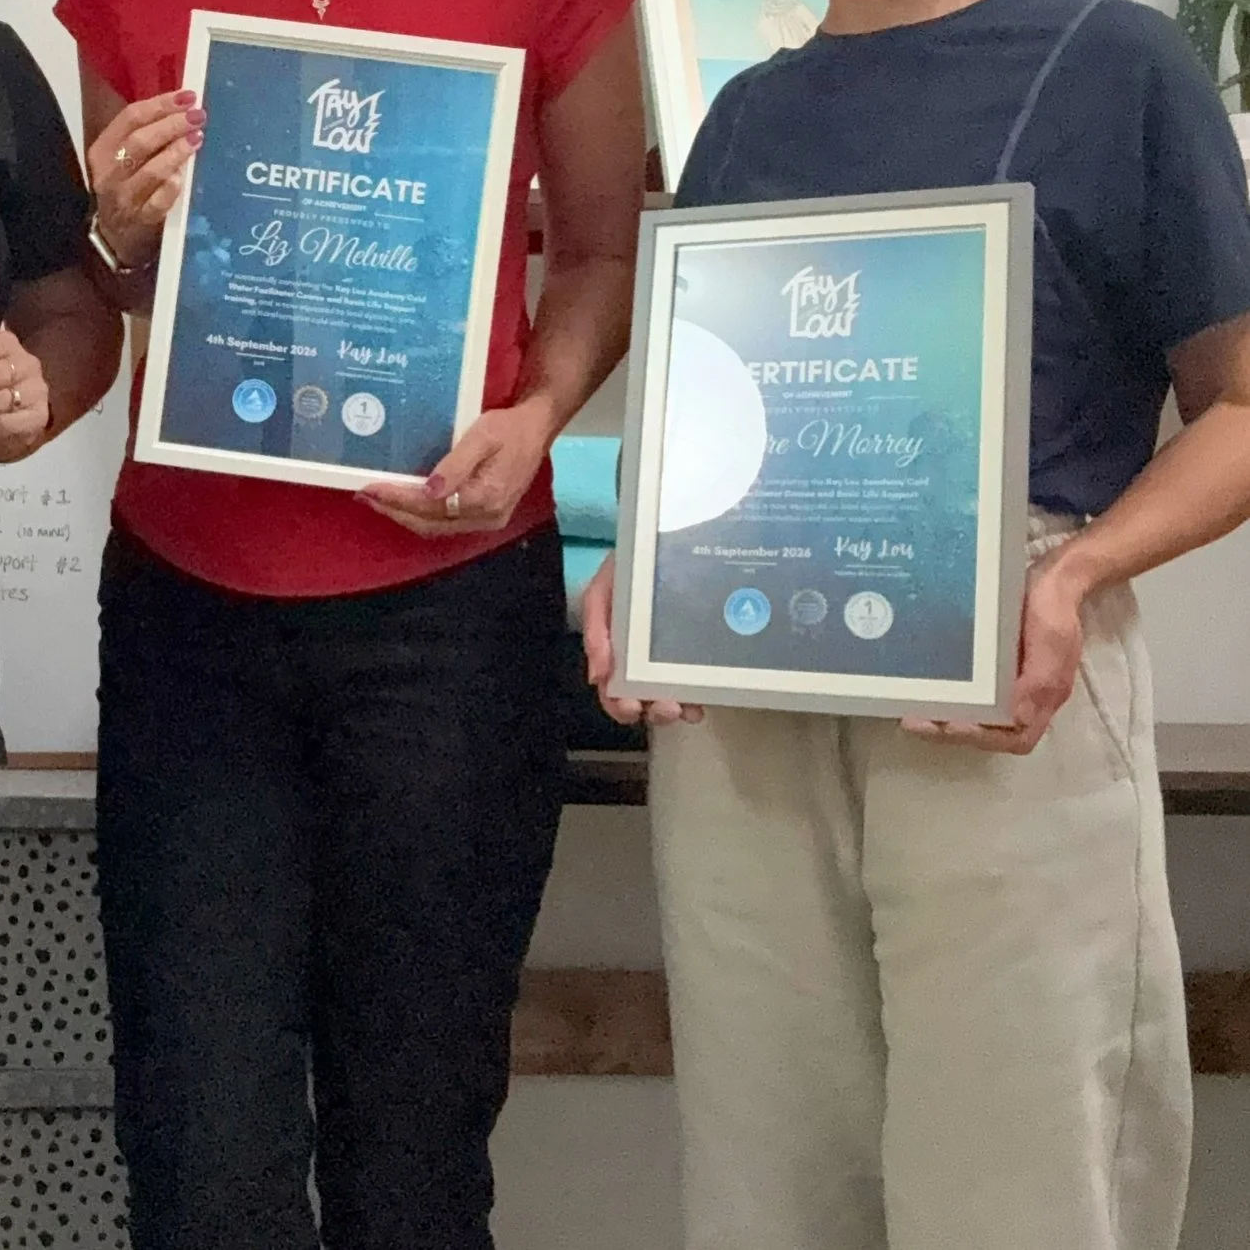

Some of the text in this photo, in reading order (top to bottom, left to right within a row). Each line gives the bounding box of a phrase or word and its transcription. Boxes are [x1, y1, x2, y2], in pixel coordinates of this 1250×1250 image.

[246, 161, 427, 205] CERTIFICATE
[239, 220, 419, 272] Liz Melville
[206, 334, 224, 346] 4th
[226, 337, 288, 353] September
[747, 356, 919, 385] ERTIFICATE
[713, 545, 779, 558] September
